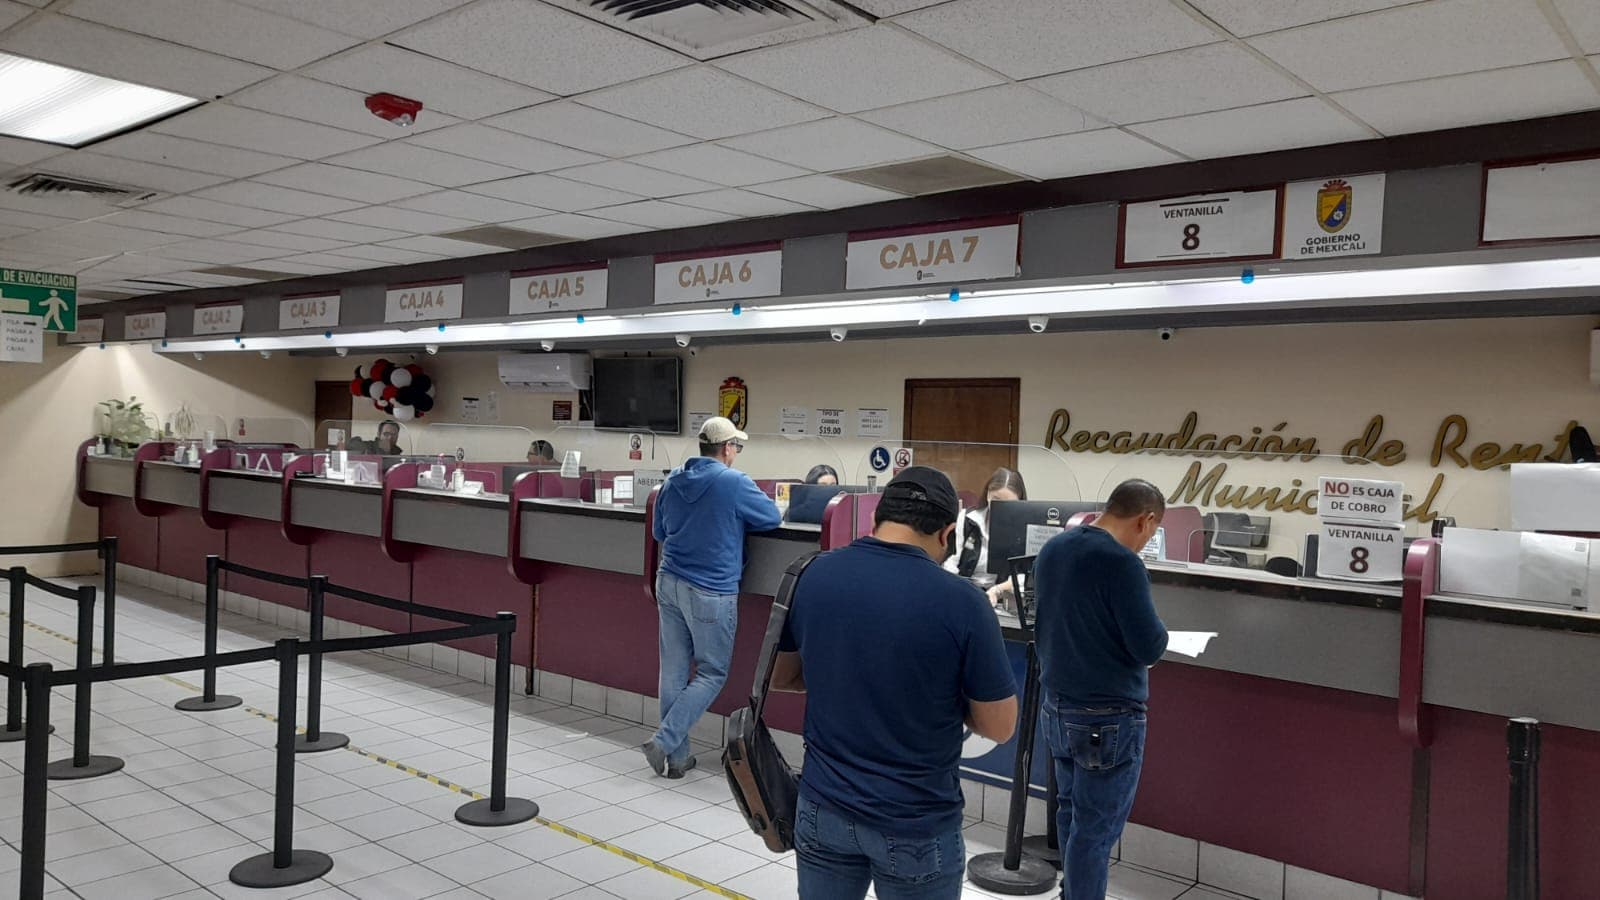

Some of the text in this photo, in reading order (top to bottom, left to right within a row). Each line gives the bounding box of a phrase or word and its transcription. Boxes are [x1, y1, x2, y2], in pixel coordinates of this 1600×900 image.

[1163, 204, 1224, 220] VENTANILLA
[1181, 223, 1201, 252] 8
[1305, 232, 1361, 247] GOBIERNO
[879, 235, 980, 270] CAJA 7
[1300, 241, 1367, 255] DE MEXICALI
[3, 269, 75, 288] DE EVACUACION
[678, 259, 752, 289] CAJA 6
[527, 275, 586, 301] CAJA 5
[398, 288, 446, 310] CAJA 4
[201, 308, 232, 327] CAJA 2
[290, 301, 327, 319] CAJA 3
[132, 317, 148, 331] CAJA
[818, 426, 842, 435] $19.00
[1044, 408, 1579, 471] Recaudación de Rent
[1166, 461, 1442, 522] Municl
[1324, 481, 1394, 498] NO ES CAJA
[1331, 501, 1386, 513] DE COBRO
[1328, 528, 1393, 543] VENTANILLA
[1349, 546, 1369, 574] 8
